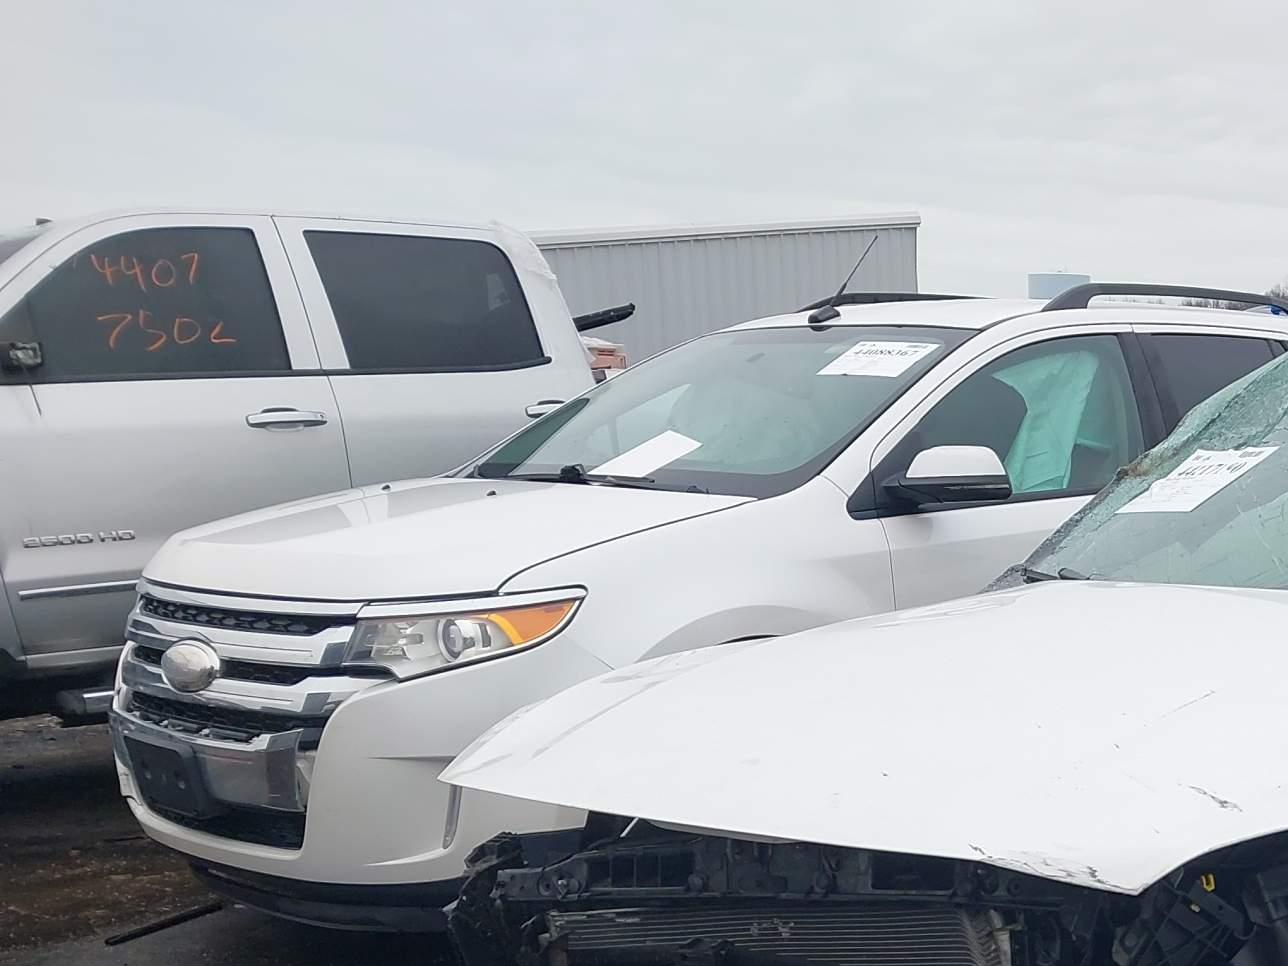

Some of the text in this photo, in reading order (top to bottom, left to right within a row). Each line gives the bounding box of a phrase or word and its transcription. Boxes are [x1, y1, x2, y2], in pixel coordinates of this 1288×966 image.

[90, 252, 199, 292] 4407
[23, 529, 136, 549] 2500 HD
